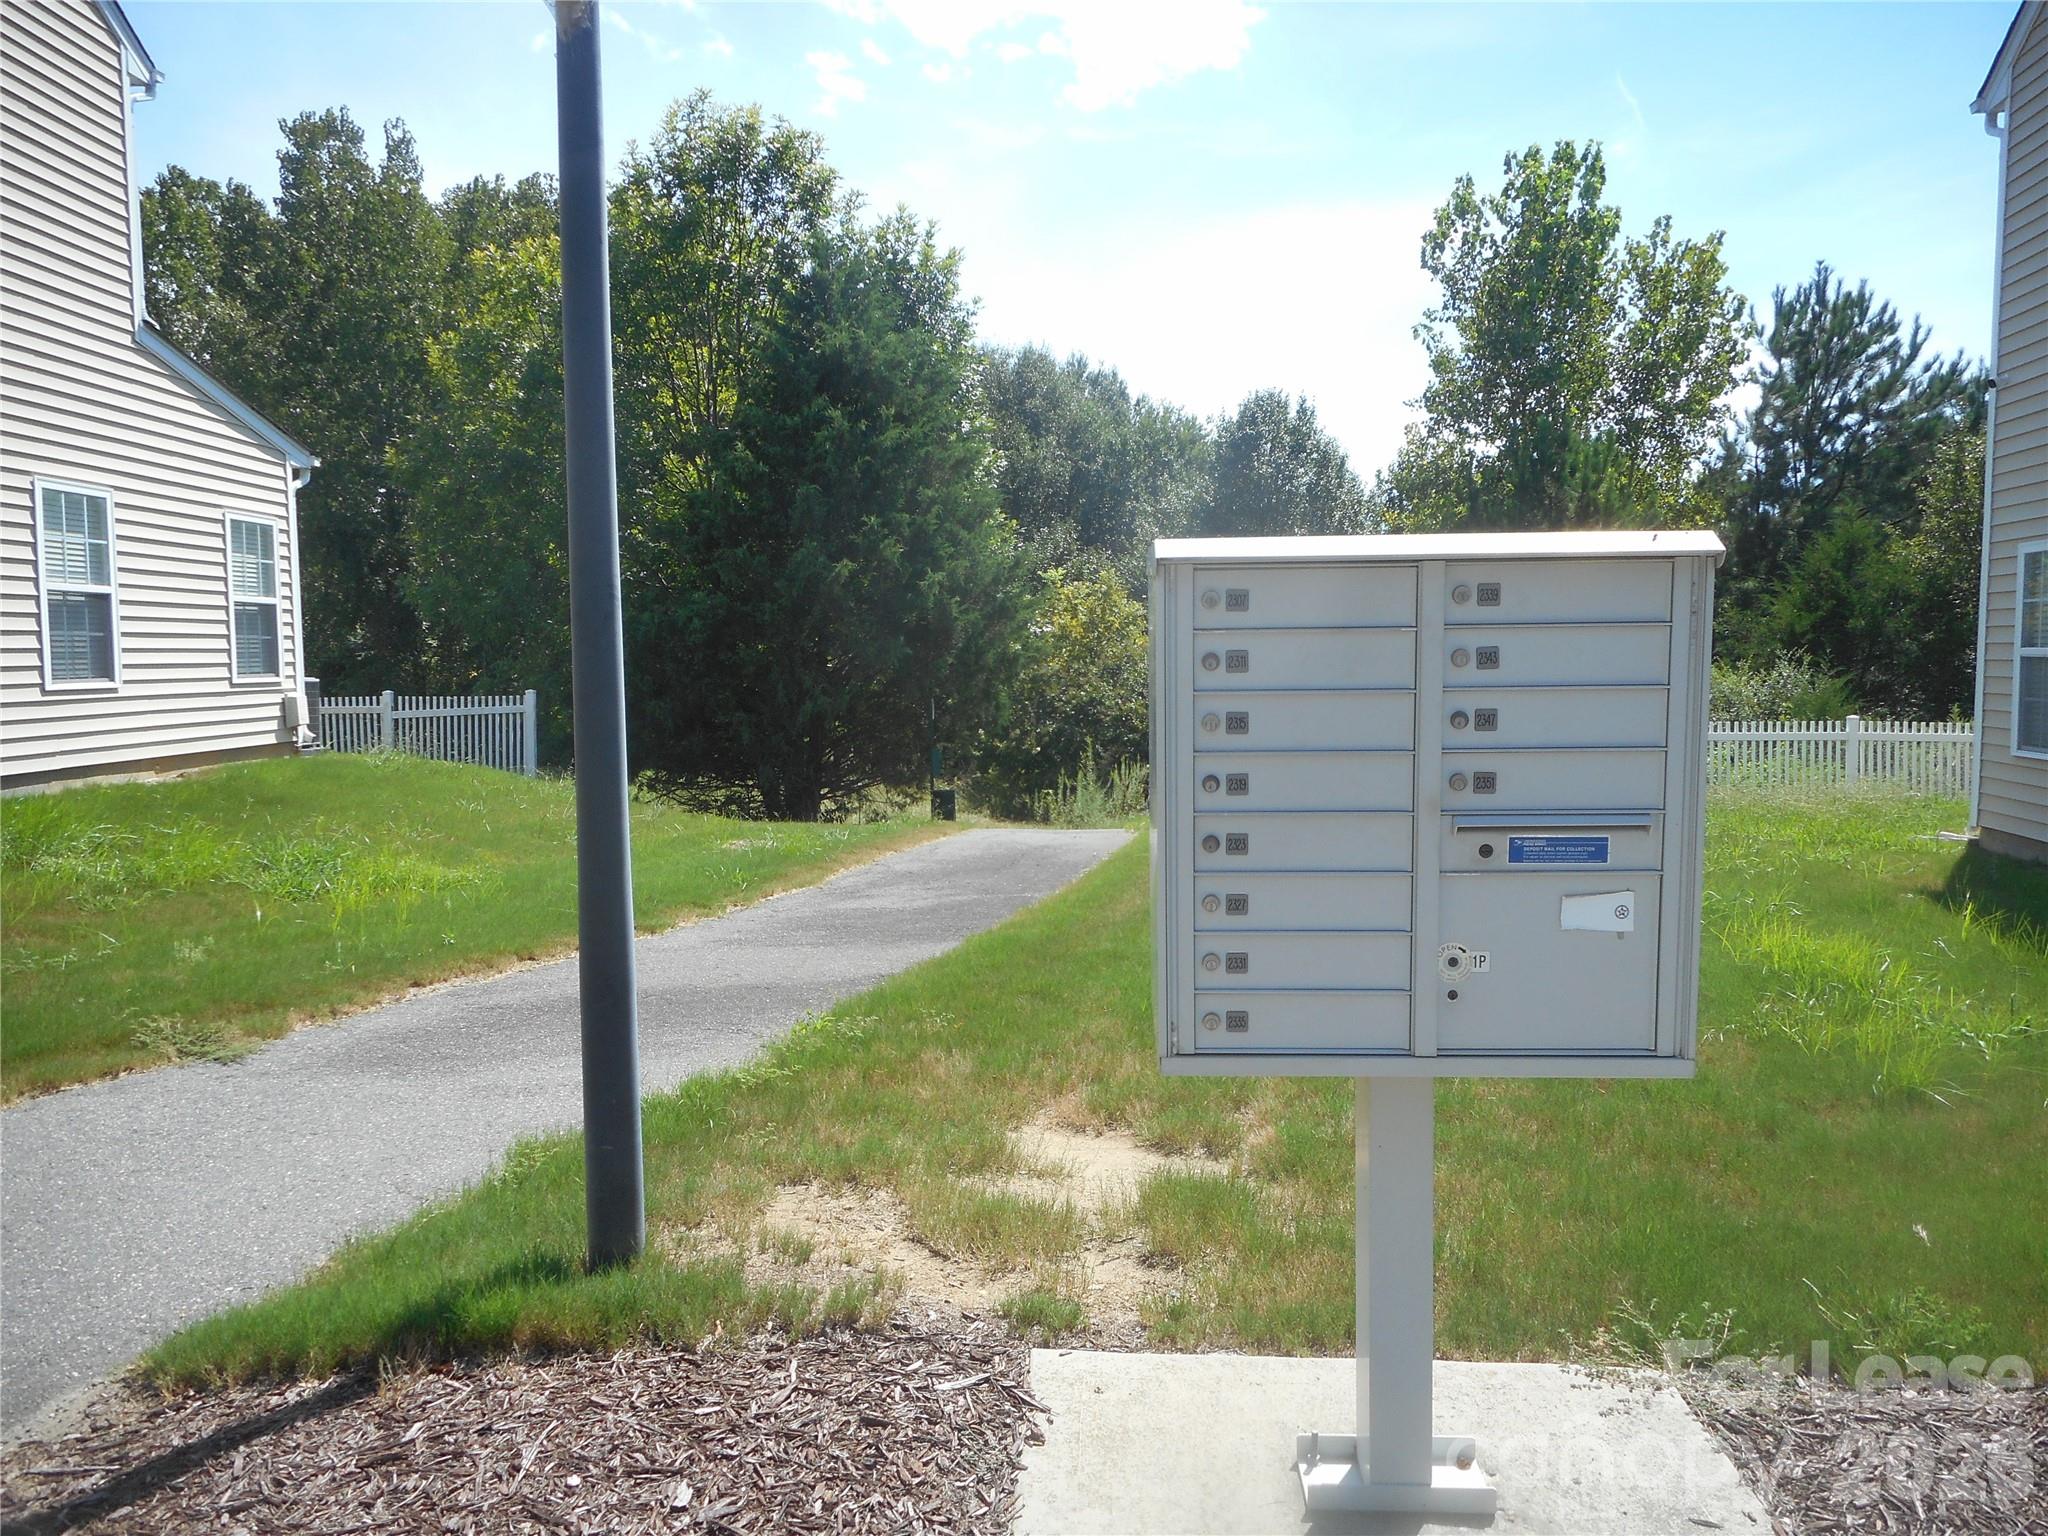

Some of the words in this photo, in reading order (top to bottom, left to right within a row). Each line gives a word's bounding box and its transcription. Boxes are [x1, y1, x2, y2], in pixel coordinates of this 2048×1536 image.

[1479, 588, 1499, 602] 2339
[1227, 655, 1247, 669] 2311
[1478, 651, 1498, 665] 2343
[1227, 716, 1247, 730] 2315
[1476, 713, 1496, 727] 2347
[1228, 778, 1247, 792] 2319
[1475, 776, 1495, 790] 2351
[1227, 838, 1247, 851] 2323
[1227, 898, 1247, 911] 2327
[1227, 957, 1246, 970] 2331
[1472, 954, 1487, 969] 1P
[1227, 1015, 1247, 1029] 2335
